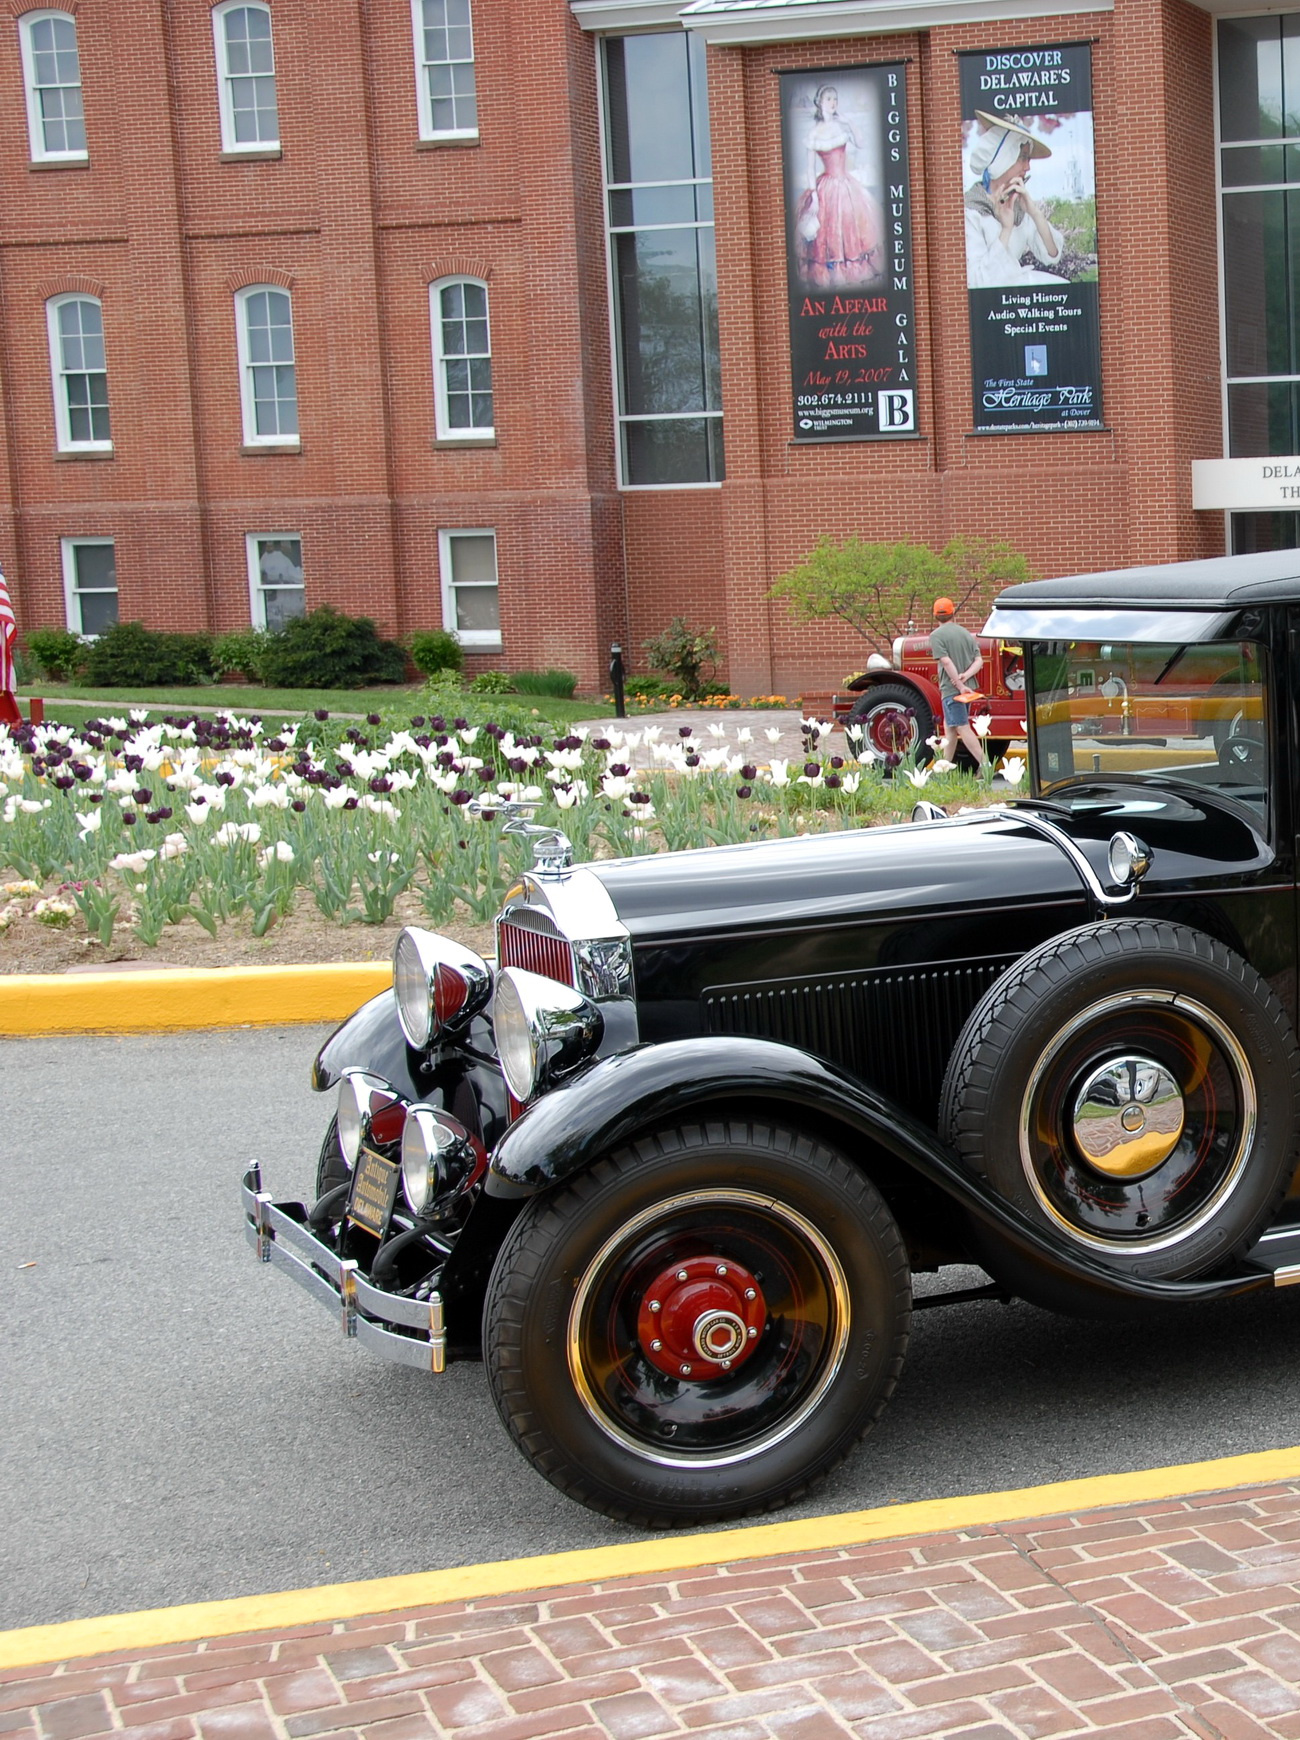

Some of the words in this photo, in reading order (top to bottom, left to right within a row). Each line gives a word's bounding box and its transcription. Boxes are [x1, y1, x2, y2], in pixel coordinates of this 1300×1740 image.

[985, 51, 1063, 71] DISCOVER
[979, 68, 1071, 90] DELAWARE'S
[993, 91, 1058, 110] CAPITAL
[887, 73, 900, 162] BIGGS
[890, 185, 908, 290] MUSEUM
[1002, 294, 1031, 306] Living
[1032, 292, 1069, 304] History
[988, 310, 1016, 320] Audio
[1017, 308, 1055, 319] Walking
[1056, 306, 1082, 317] Tours
[818, 311, 850, 339] with
[852, 313, 874, 336] the
[1004, 323, 1036, 336] Special
[1038, 322, 1068, 333] Events
[895, 313, 909, 381] GALA
[804, 370, 832, 396] May
[835, 369, 851, 387] 19,
[855, 367, 893, 383] 2007
[984, 379, 997, 388] The
[998, 378, 1015, 387] First
[1016, 378, 1034, 387] State
[797, 392, 873, 406] 302.674.2111
[982, 387, 1052, 412] Heritage
[1056, 385, 1093, 405] Park
[797, 407, 874, 418] www.biggsmuseum.org
[882, 394, 910, 427] B
[1069, 408, 1091, 417] Dover
[356, 1173, 389, 1208] Automobile
[353, 1197, 384, 1225] DELAWARE
